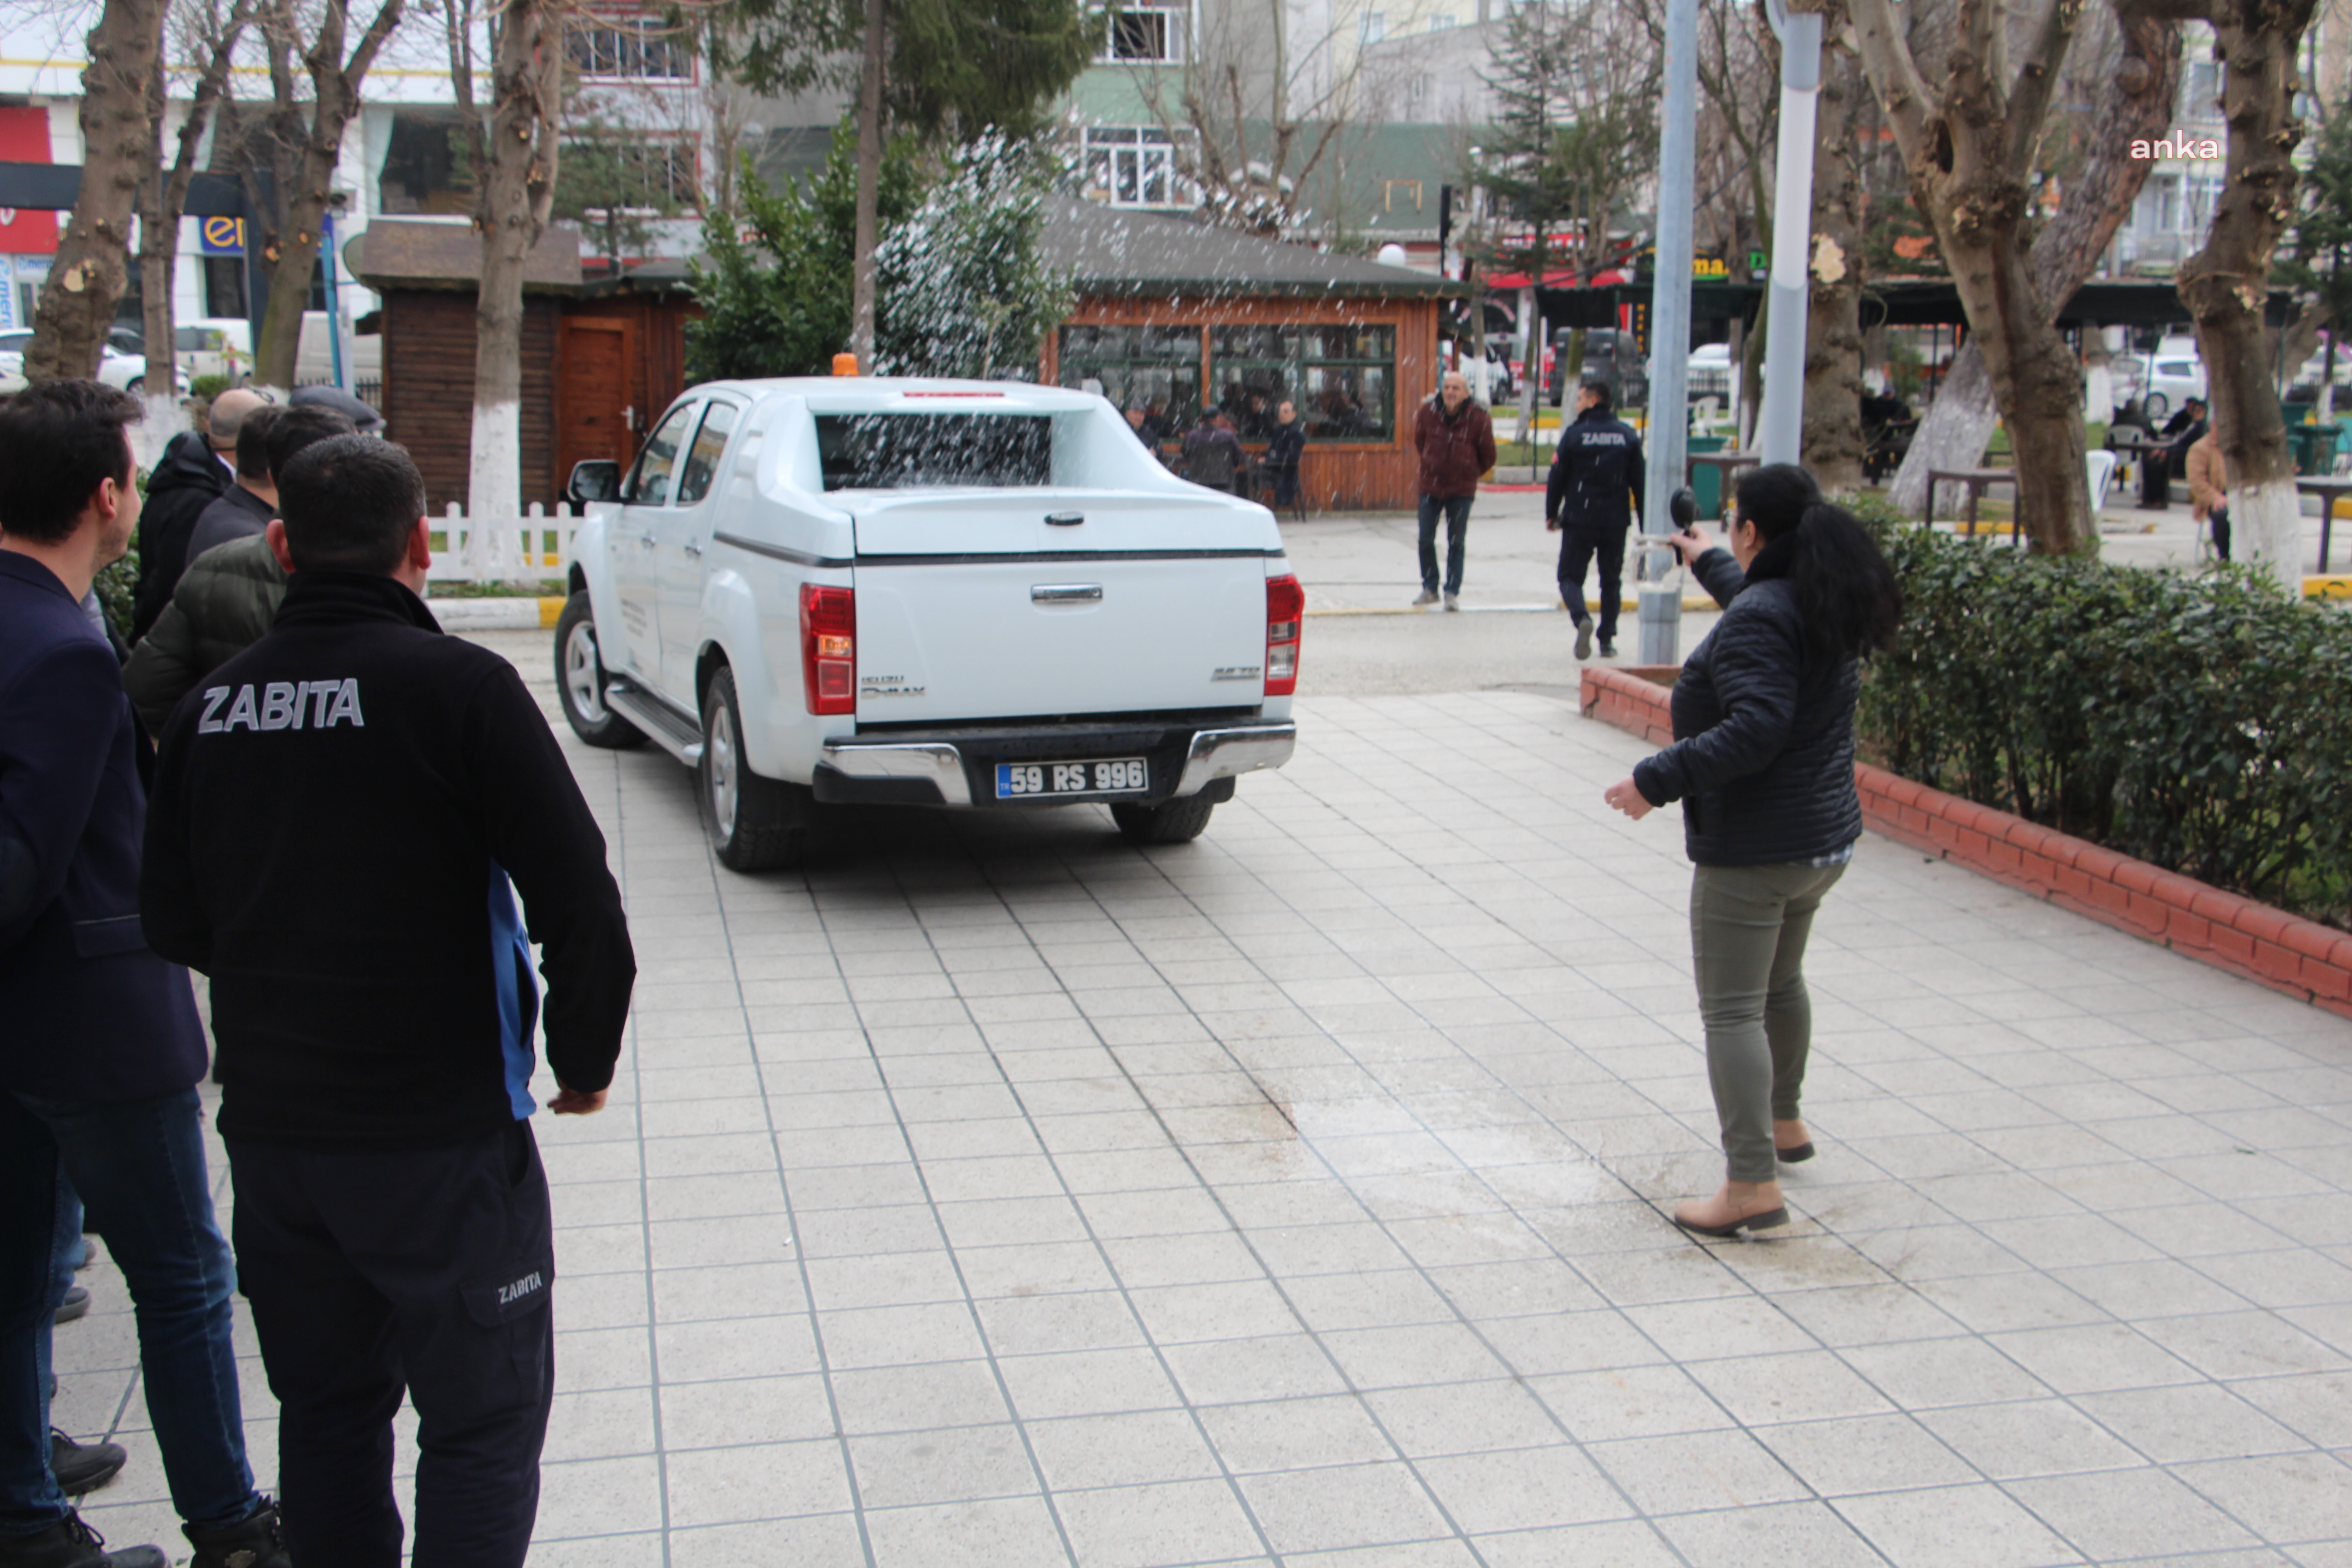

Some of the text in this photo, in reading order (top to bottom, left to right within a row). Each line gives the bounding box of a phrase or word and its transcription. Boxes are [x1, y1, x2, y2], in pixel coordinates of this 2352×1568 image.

[1581, 432, 1627, 446] ZABITA
[198, 678, 364, 734] ZABITA
[1010, 766, 1043, 793] 59
[1053, 764, 1086, 791] RS
[1095, 761, 1143, 789] 996
[498, 1271, 542, 1304] ZABITA
